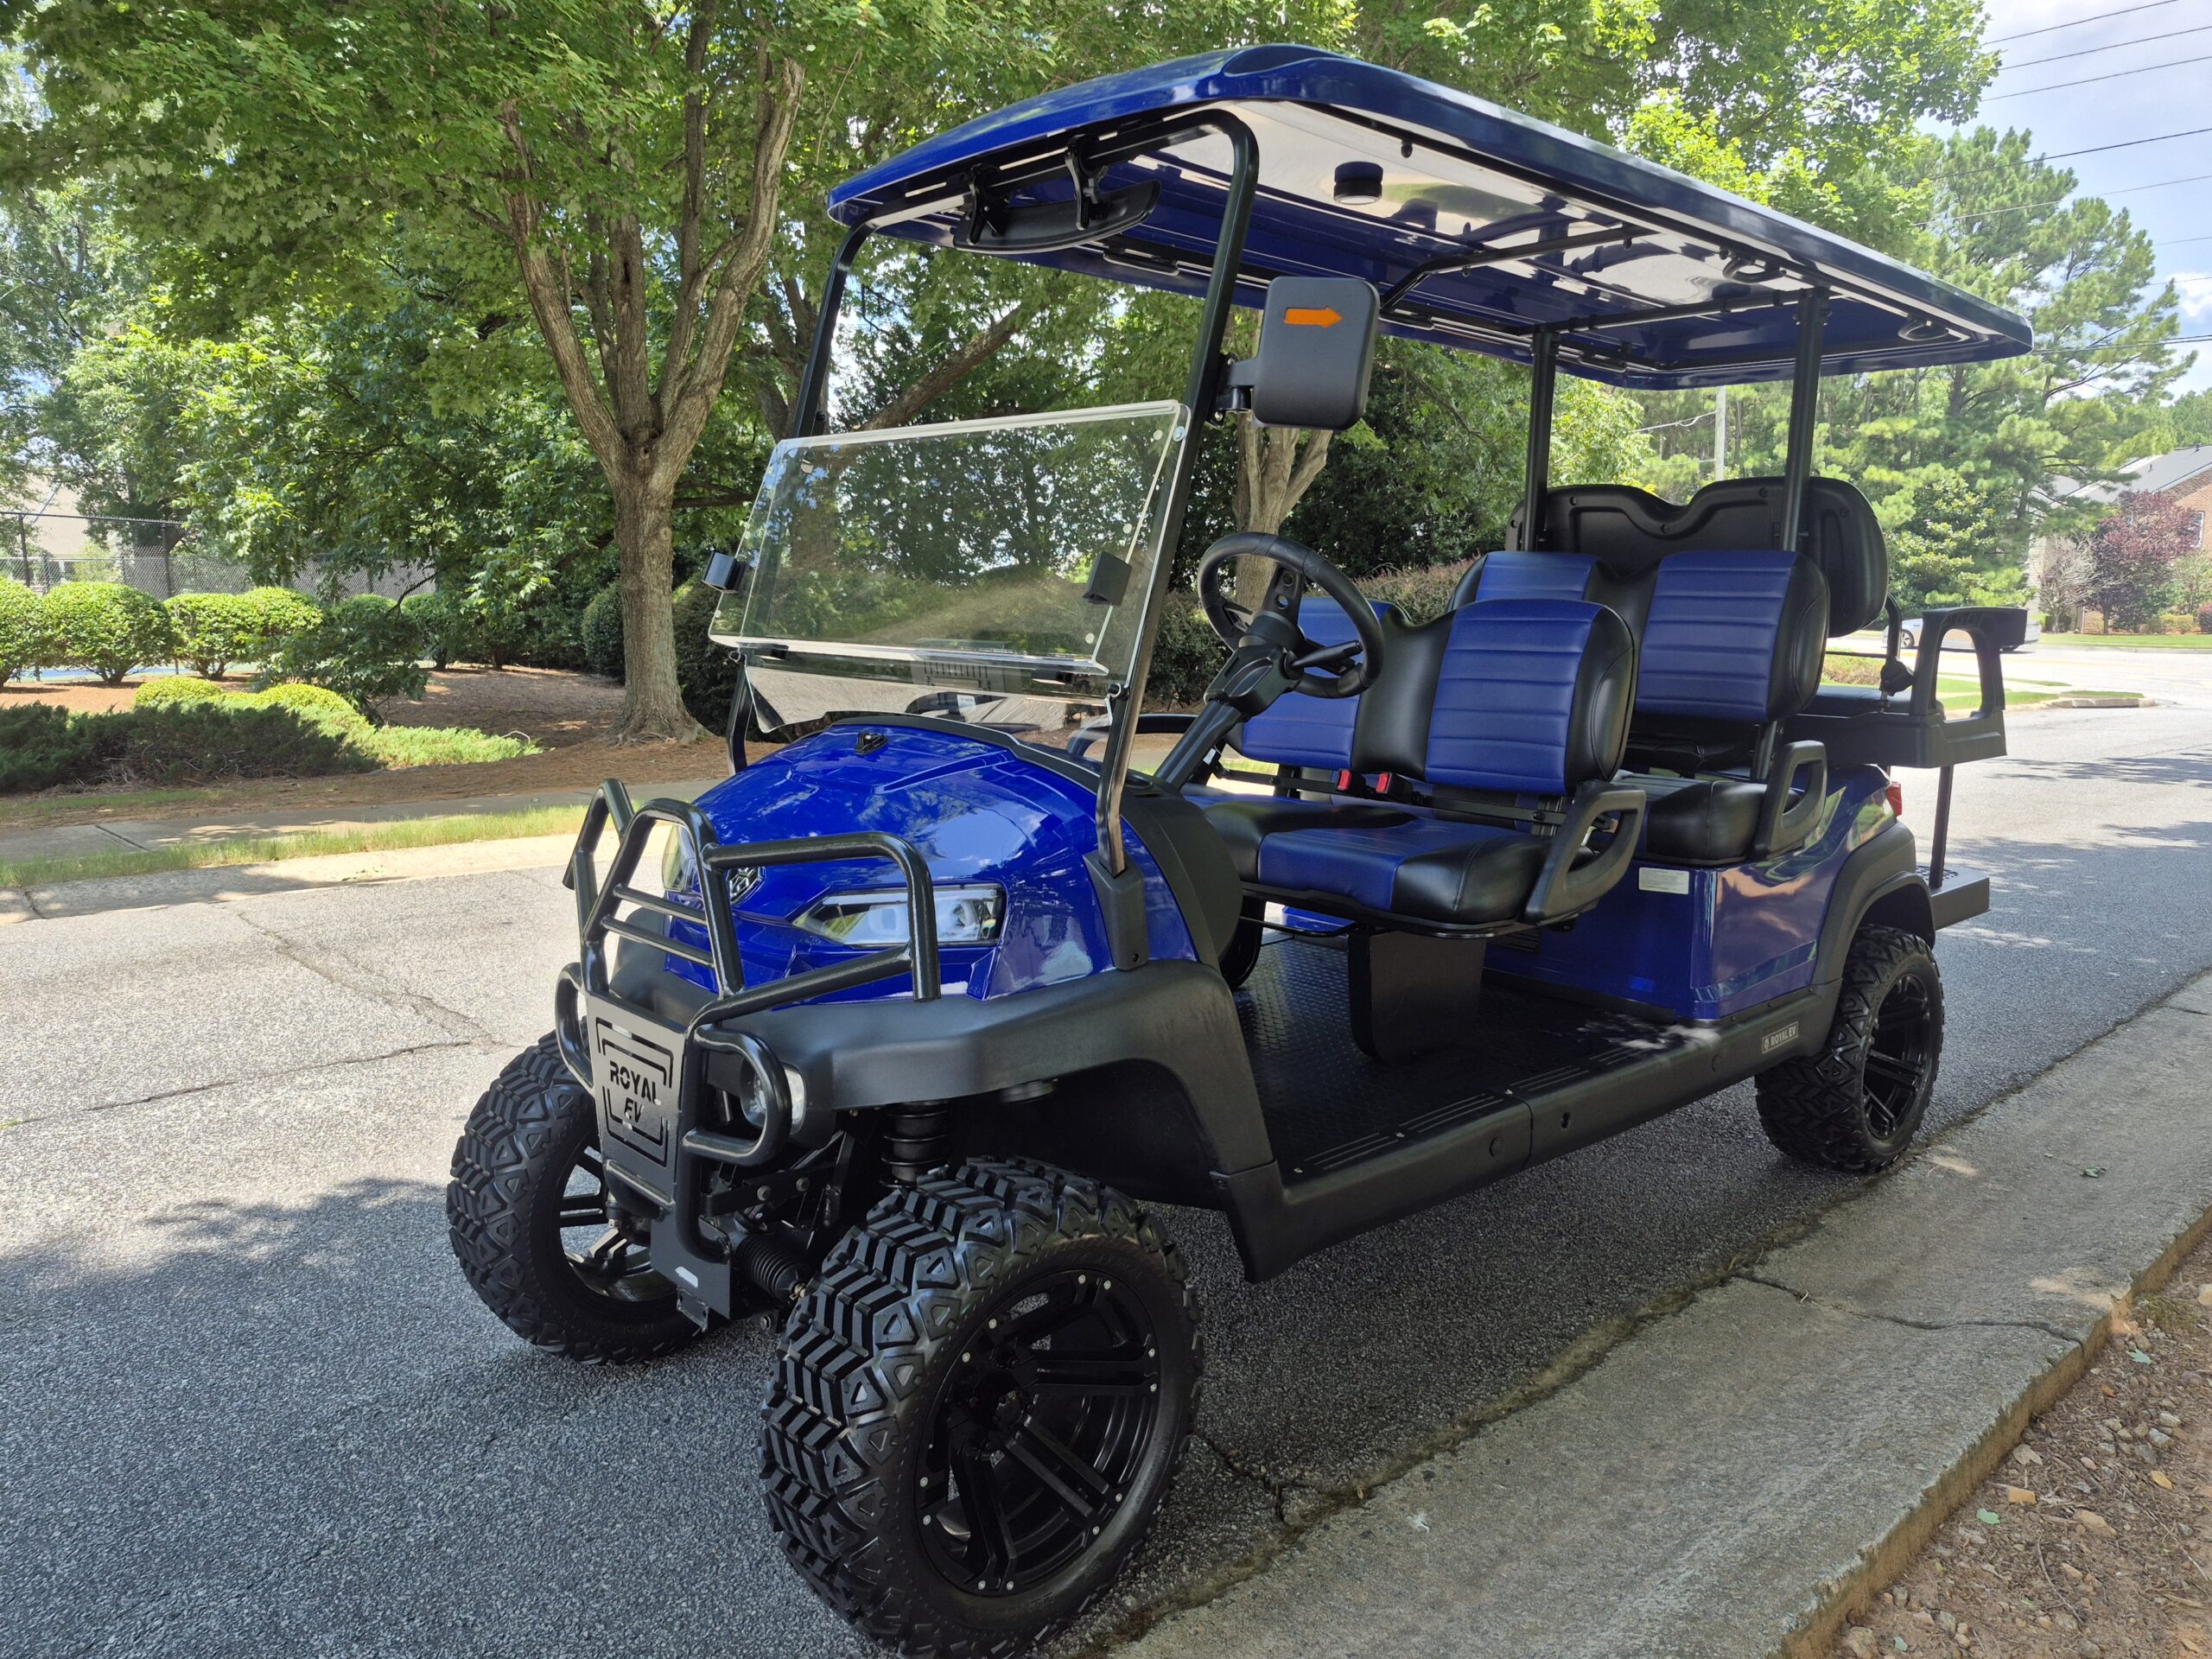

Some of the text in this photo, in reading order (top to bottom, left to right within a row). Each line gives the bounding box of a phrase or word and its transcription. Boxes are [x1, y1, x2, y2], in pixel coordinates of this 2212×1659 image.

[1770, 1026, 1796, 1046] ROYAL EV
[609, 1060, 661, 1106] ROYAL
[624, 1097, 645, 1123] EV
